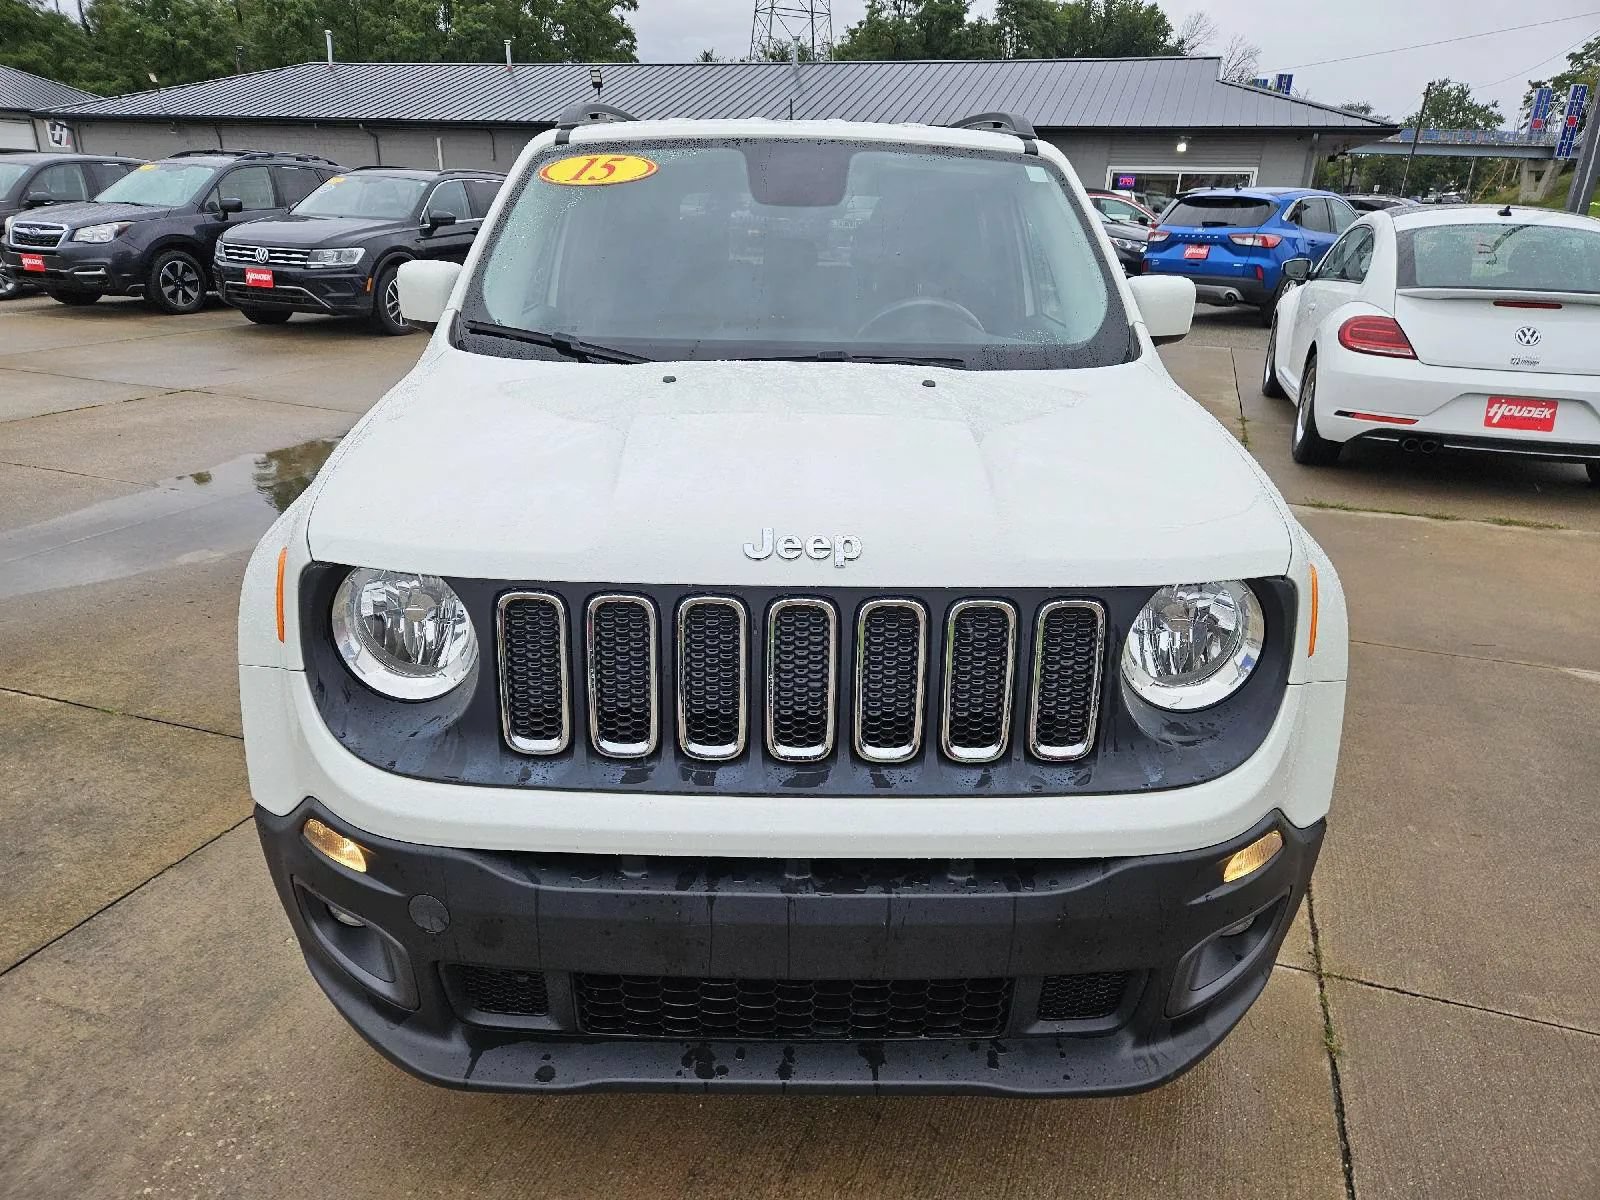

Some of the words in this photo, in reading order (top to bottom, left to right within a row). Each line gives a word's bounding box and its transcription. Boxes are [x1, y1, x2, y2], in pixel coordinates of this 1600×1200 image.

[565, 157, 626, 181] 15
[1487, 403, 1555, 424] HOUDEK
[743, 527, 863, 569] Jeep
